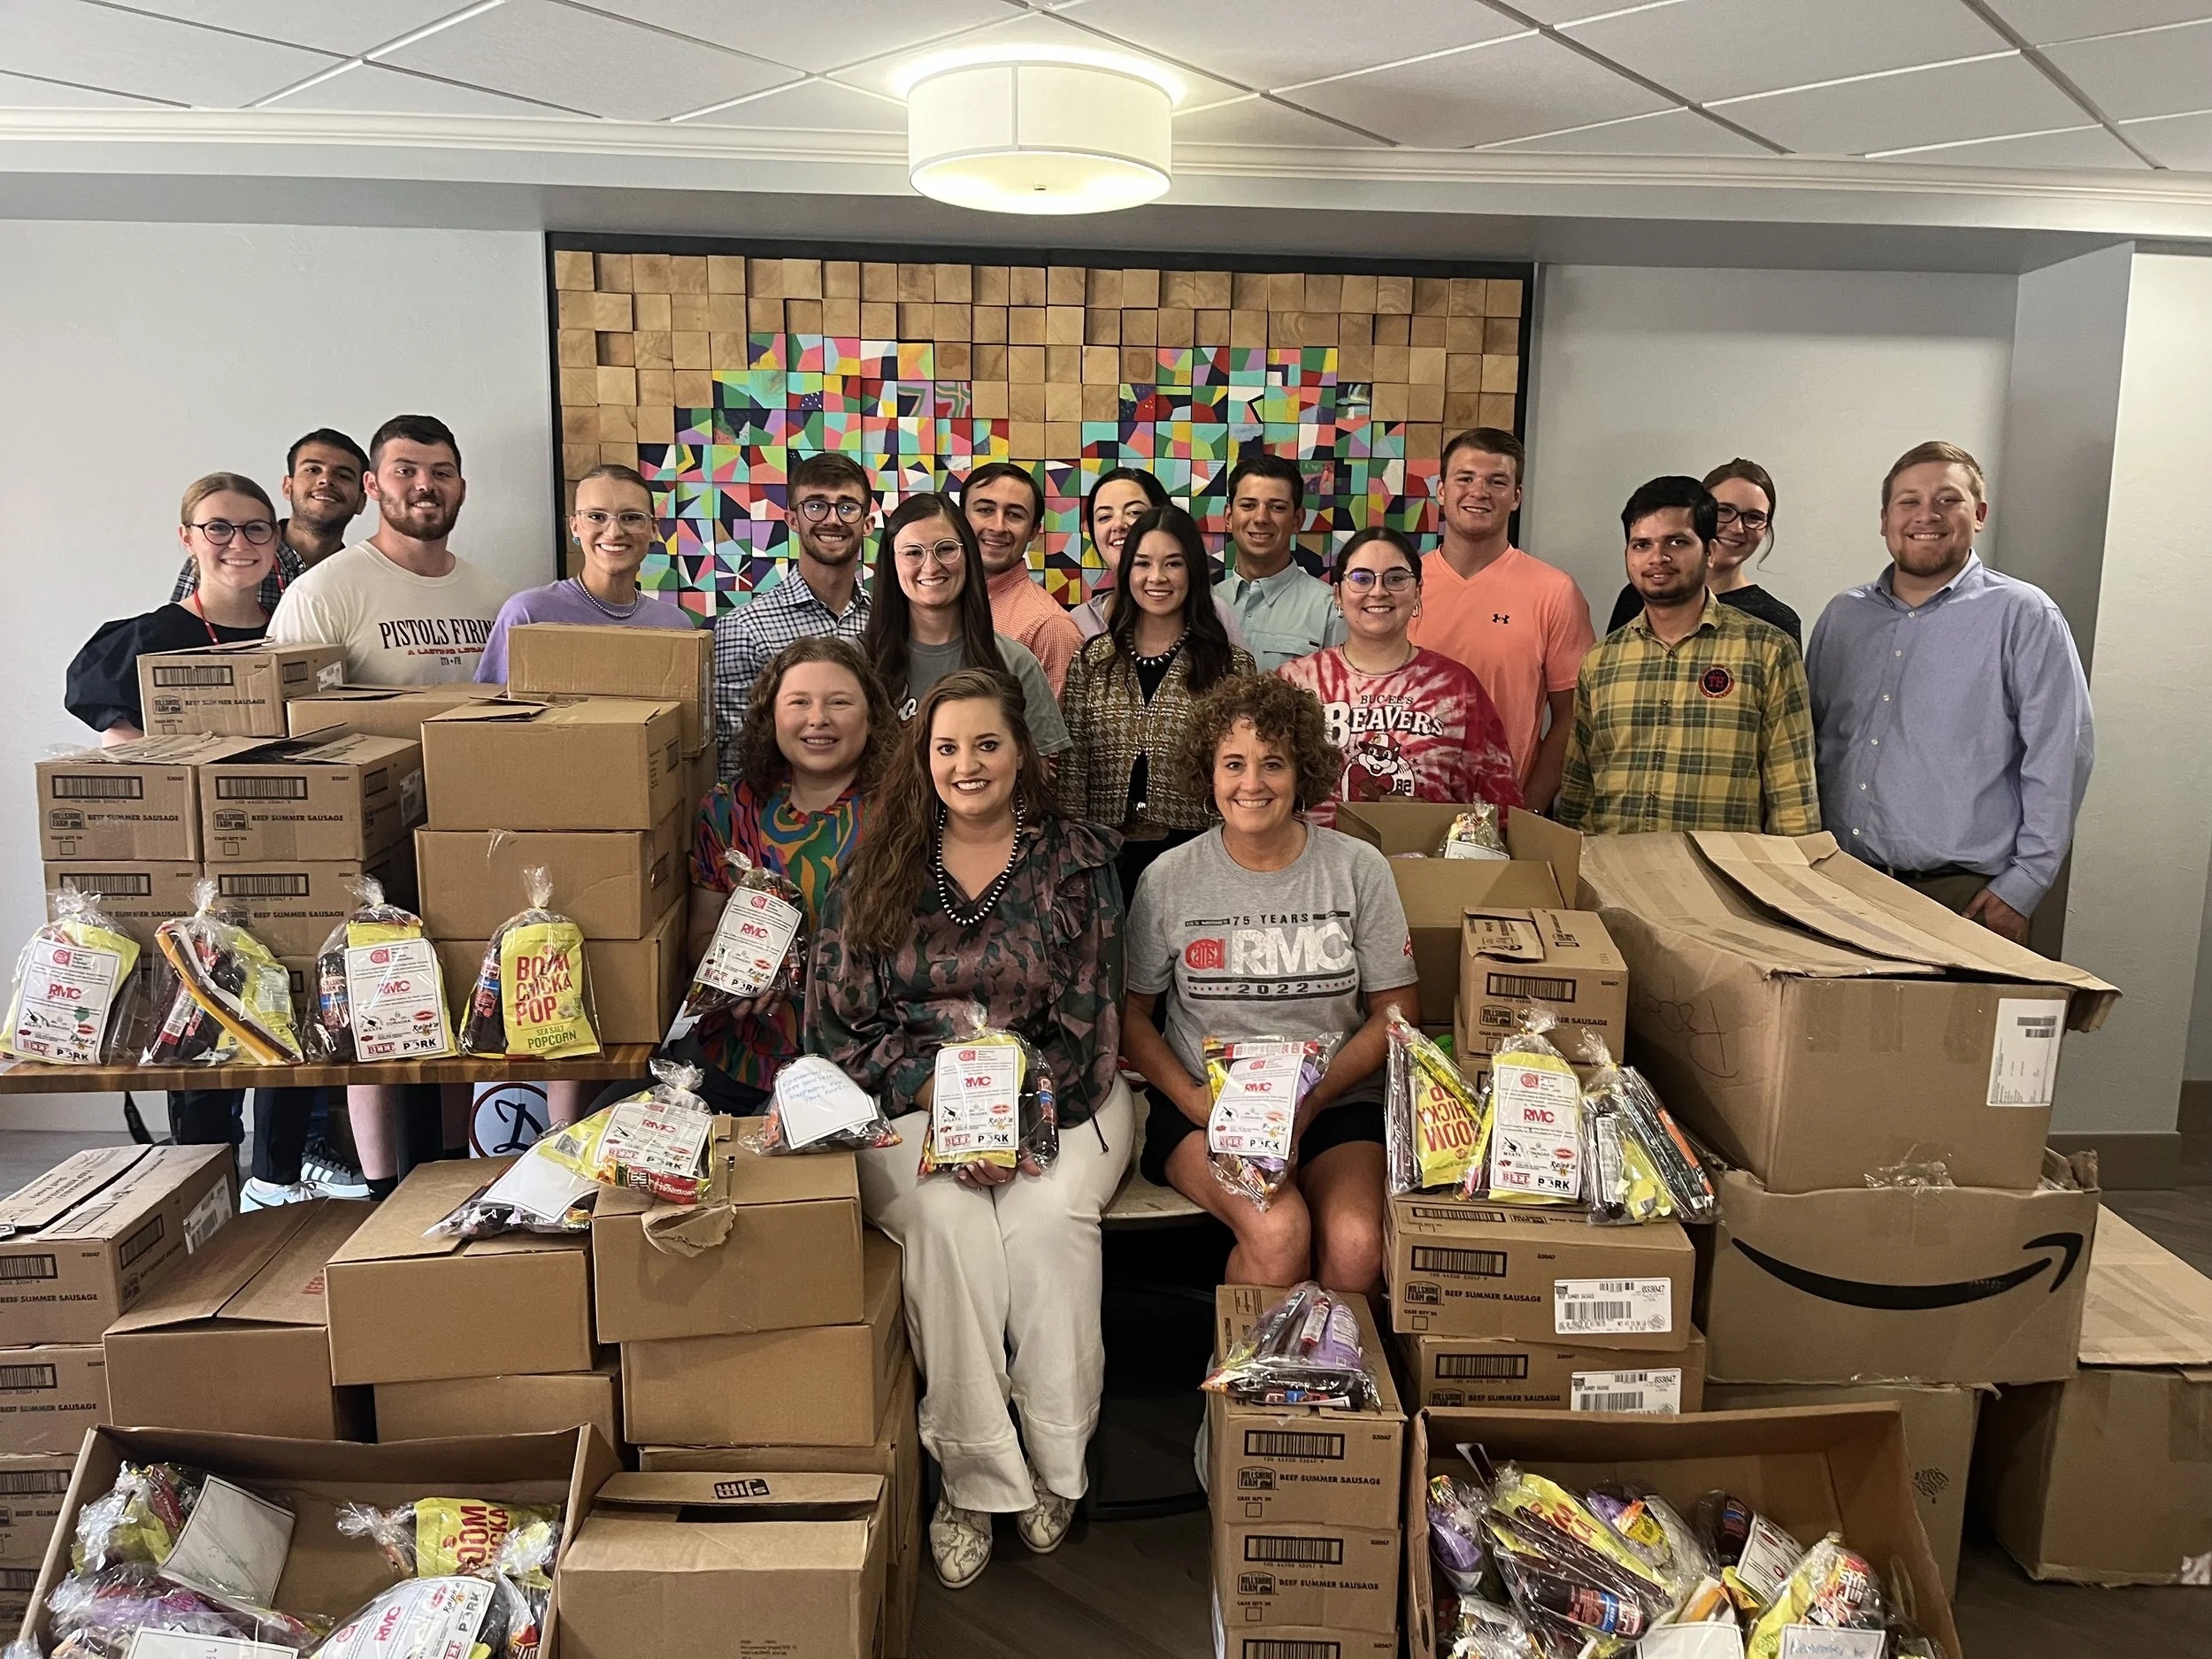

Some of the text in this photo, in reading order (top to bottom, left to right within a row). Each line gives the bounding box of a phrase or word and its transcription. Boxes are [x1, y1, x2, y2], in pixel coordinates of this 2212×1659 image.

[378, 618, 495, 649] PISTOLS FIRIN
[1360, 695, 1414, 705] BUC-EE'S
[1324, 701, 1445, 749] BEAVERS
[1395, 779, 1412, 793] 82
[1233, 912, 1309, 926] 75 YEARS
[741, 923, 768, 939] RMC
[1232, 921, 1352, 974] RMC
[49, 983, 82, 1000] RMC
[1238, 983, 1309, 995] 2022
[515, 996, 557, 1026] POP
[1571, 1018, 1608, 1026] SAUSAGE
[527, 1030, 577, 1049] POPCORN
[367, 1042, 396, 1054] BEEF
[1244, 1082, 1272, 1092] RMC
[1417, 1100, 1466, 1125] HICKA
[1523, 1108, 1555, 1124] RMC
[642, 1119, 676, 1133] RMC
[1425, 1120, 1479, 1151] OOM
[1502, 1171, 1531, 1186] BEEF
[1408, 1285, 1439, 1294] HILLSHIRE
[1465, 1291, 1501, 1300] SUMMER
[1503, 1294, 1541, 1302] SAUSAGE
[1408, 1293, 1425, 1302] FARM
[1301, 1474, 1338, 1483] SUMMER
[457, 1505, 489, 1566] OOM
[1240, 1576, 1272, 1585] HILLSHIRE
[1301, 1579, 1337, 1588] SUMMER
[1340, 1582, 1379, 1591] SAUSAGE
[374, 1606, 402, 1641] RMC
